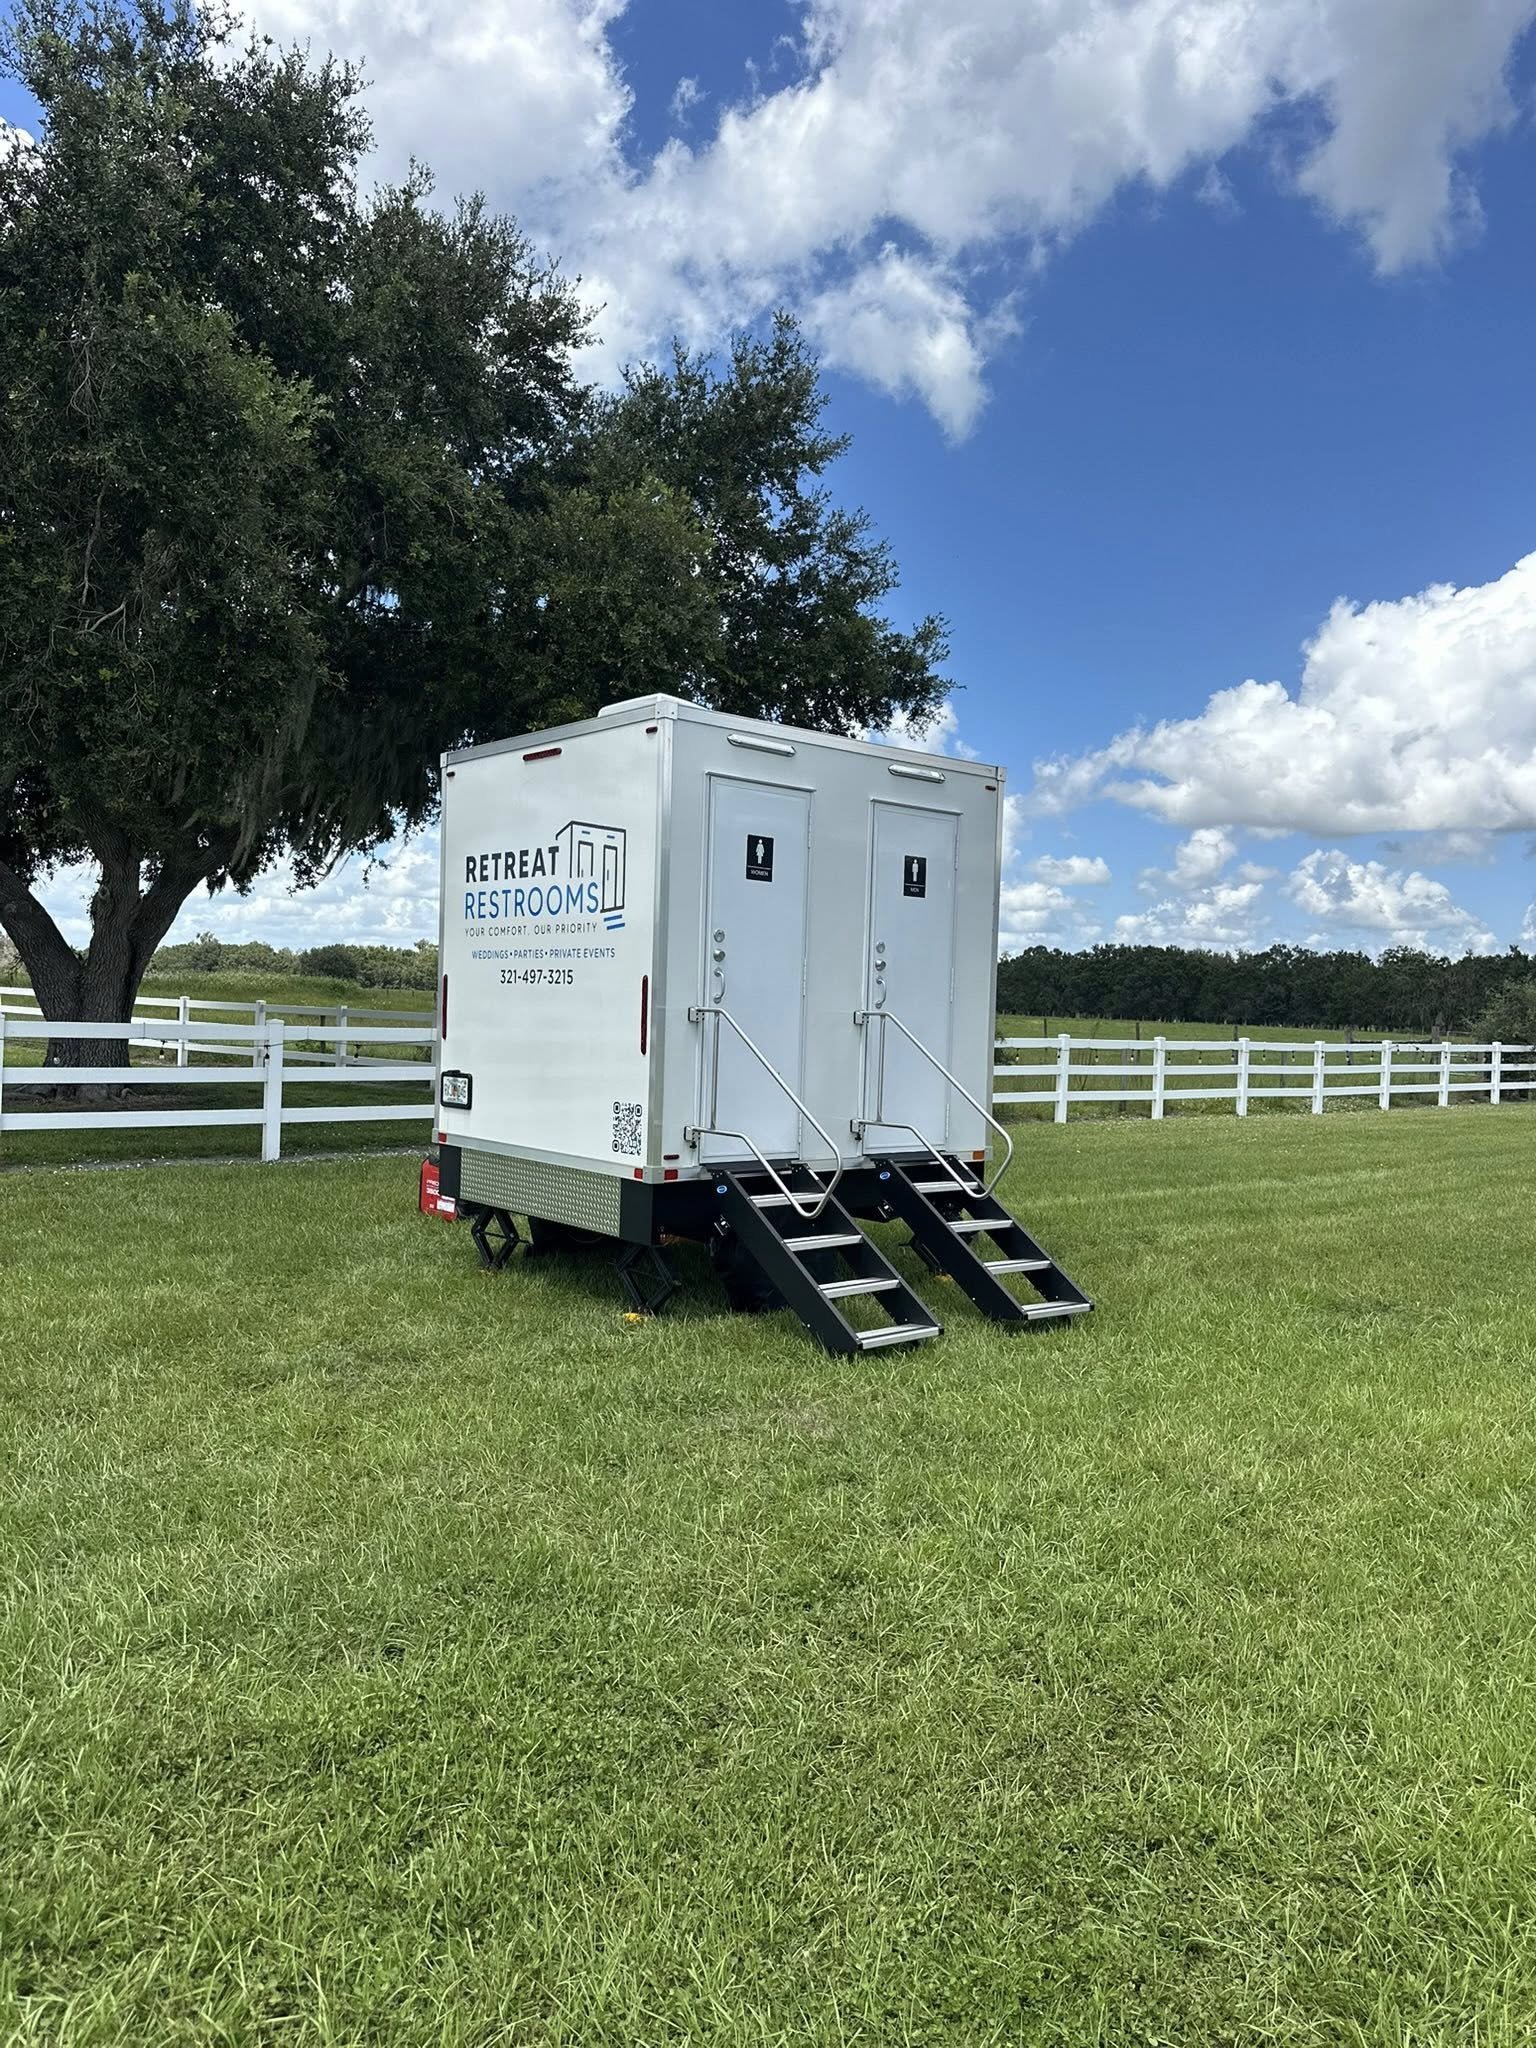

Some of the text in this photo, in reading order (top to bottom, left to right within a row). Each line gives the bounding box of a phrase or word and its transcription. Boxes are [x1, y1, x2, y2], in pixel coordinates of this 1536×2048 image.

[466, 846, 560, 883] RETREAT
[750, 869, 769, 877] WOMEN
[465, 882, 599, 919] RESTROOMS
[465, 927, 485, 937] YOUR
[534, 924, 552, 935] OUR
[555, 922, 597, 934] PRIORITY
[472, 948, 616, 959] WEDDINGS PARTIES PRIVATE EVENTS
[500, 969, 574, 985] 321-497-3215
